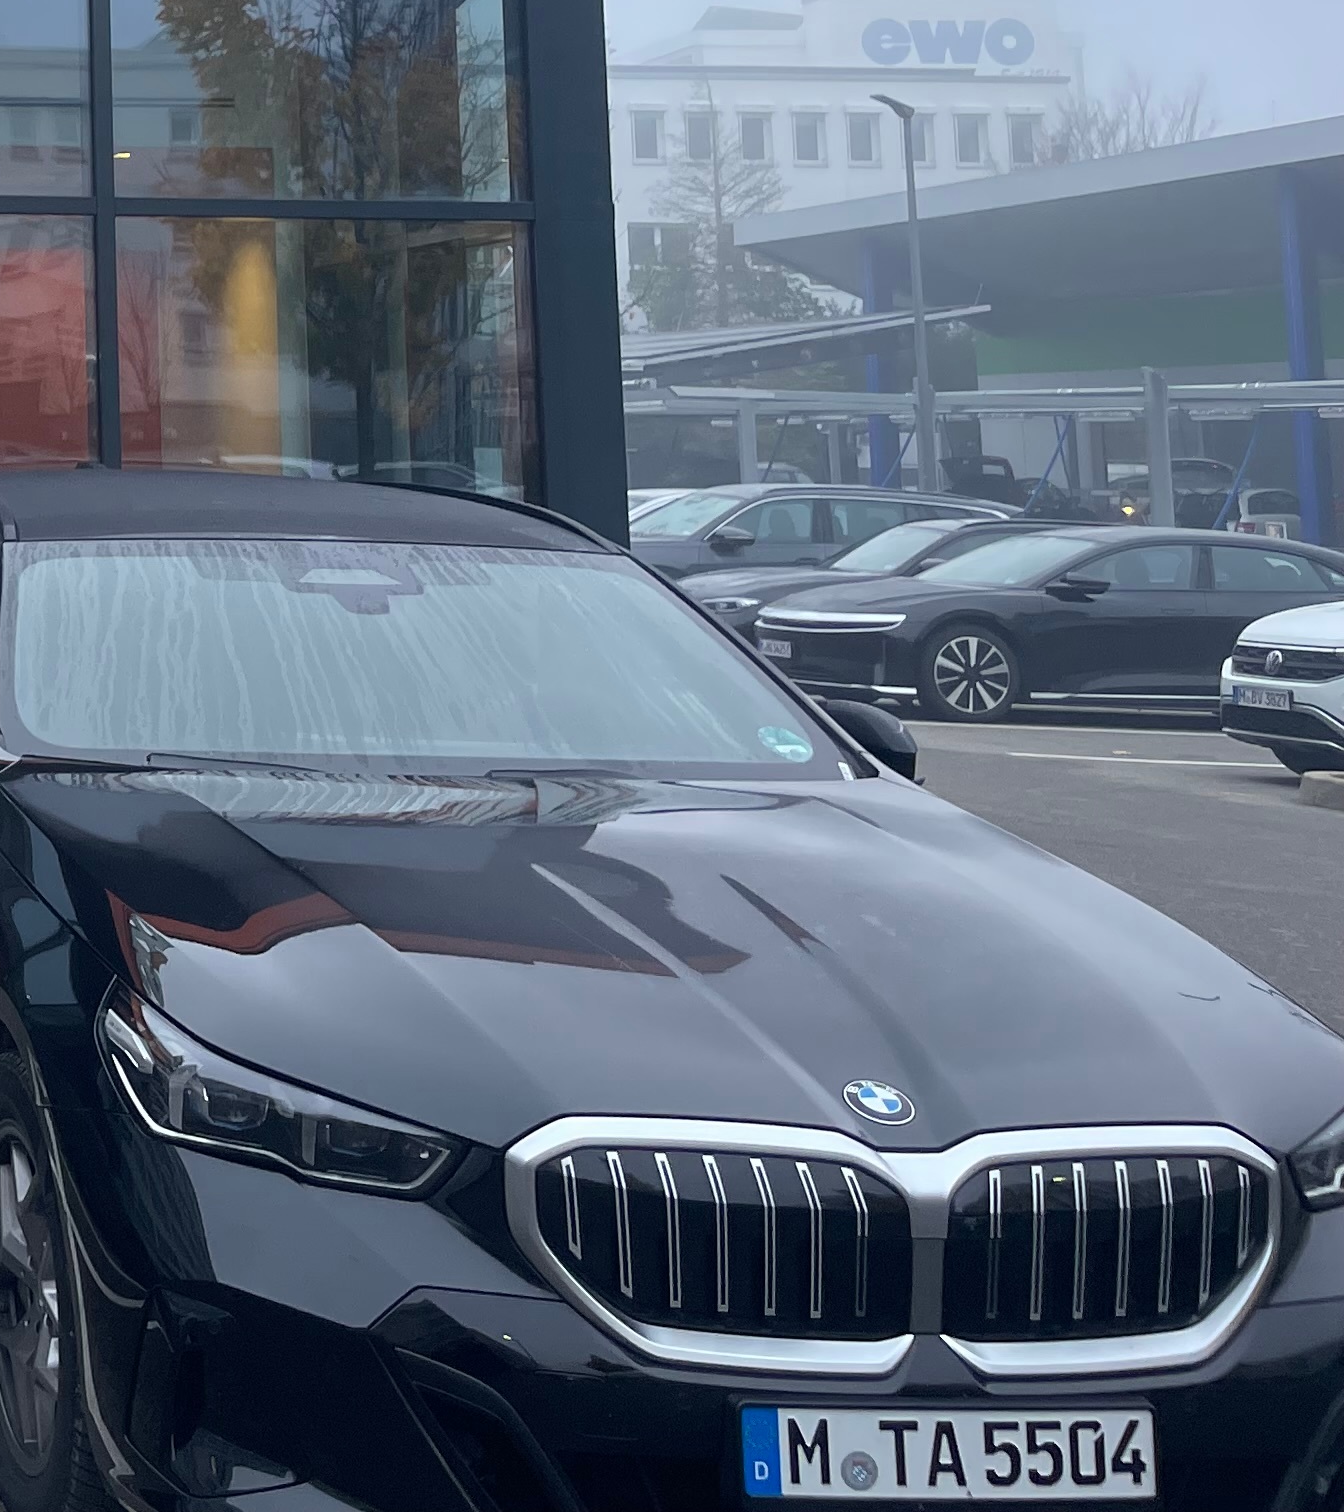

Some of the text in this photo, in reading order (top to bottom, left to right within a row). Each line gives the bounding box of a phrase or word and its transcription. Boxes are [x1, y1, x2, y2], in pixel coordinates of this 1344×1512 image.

[861, 17, 1035, 66] ewo
[754, 1460, 769, 1481] D
[787, 1418, 831, 1485] M
